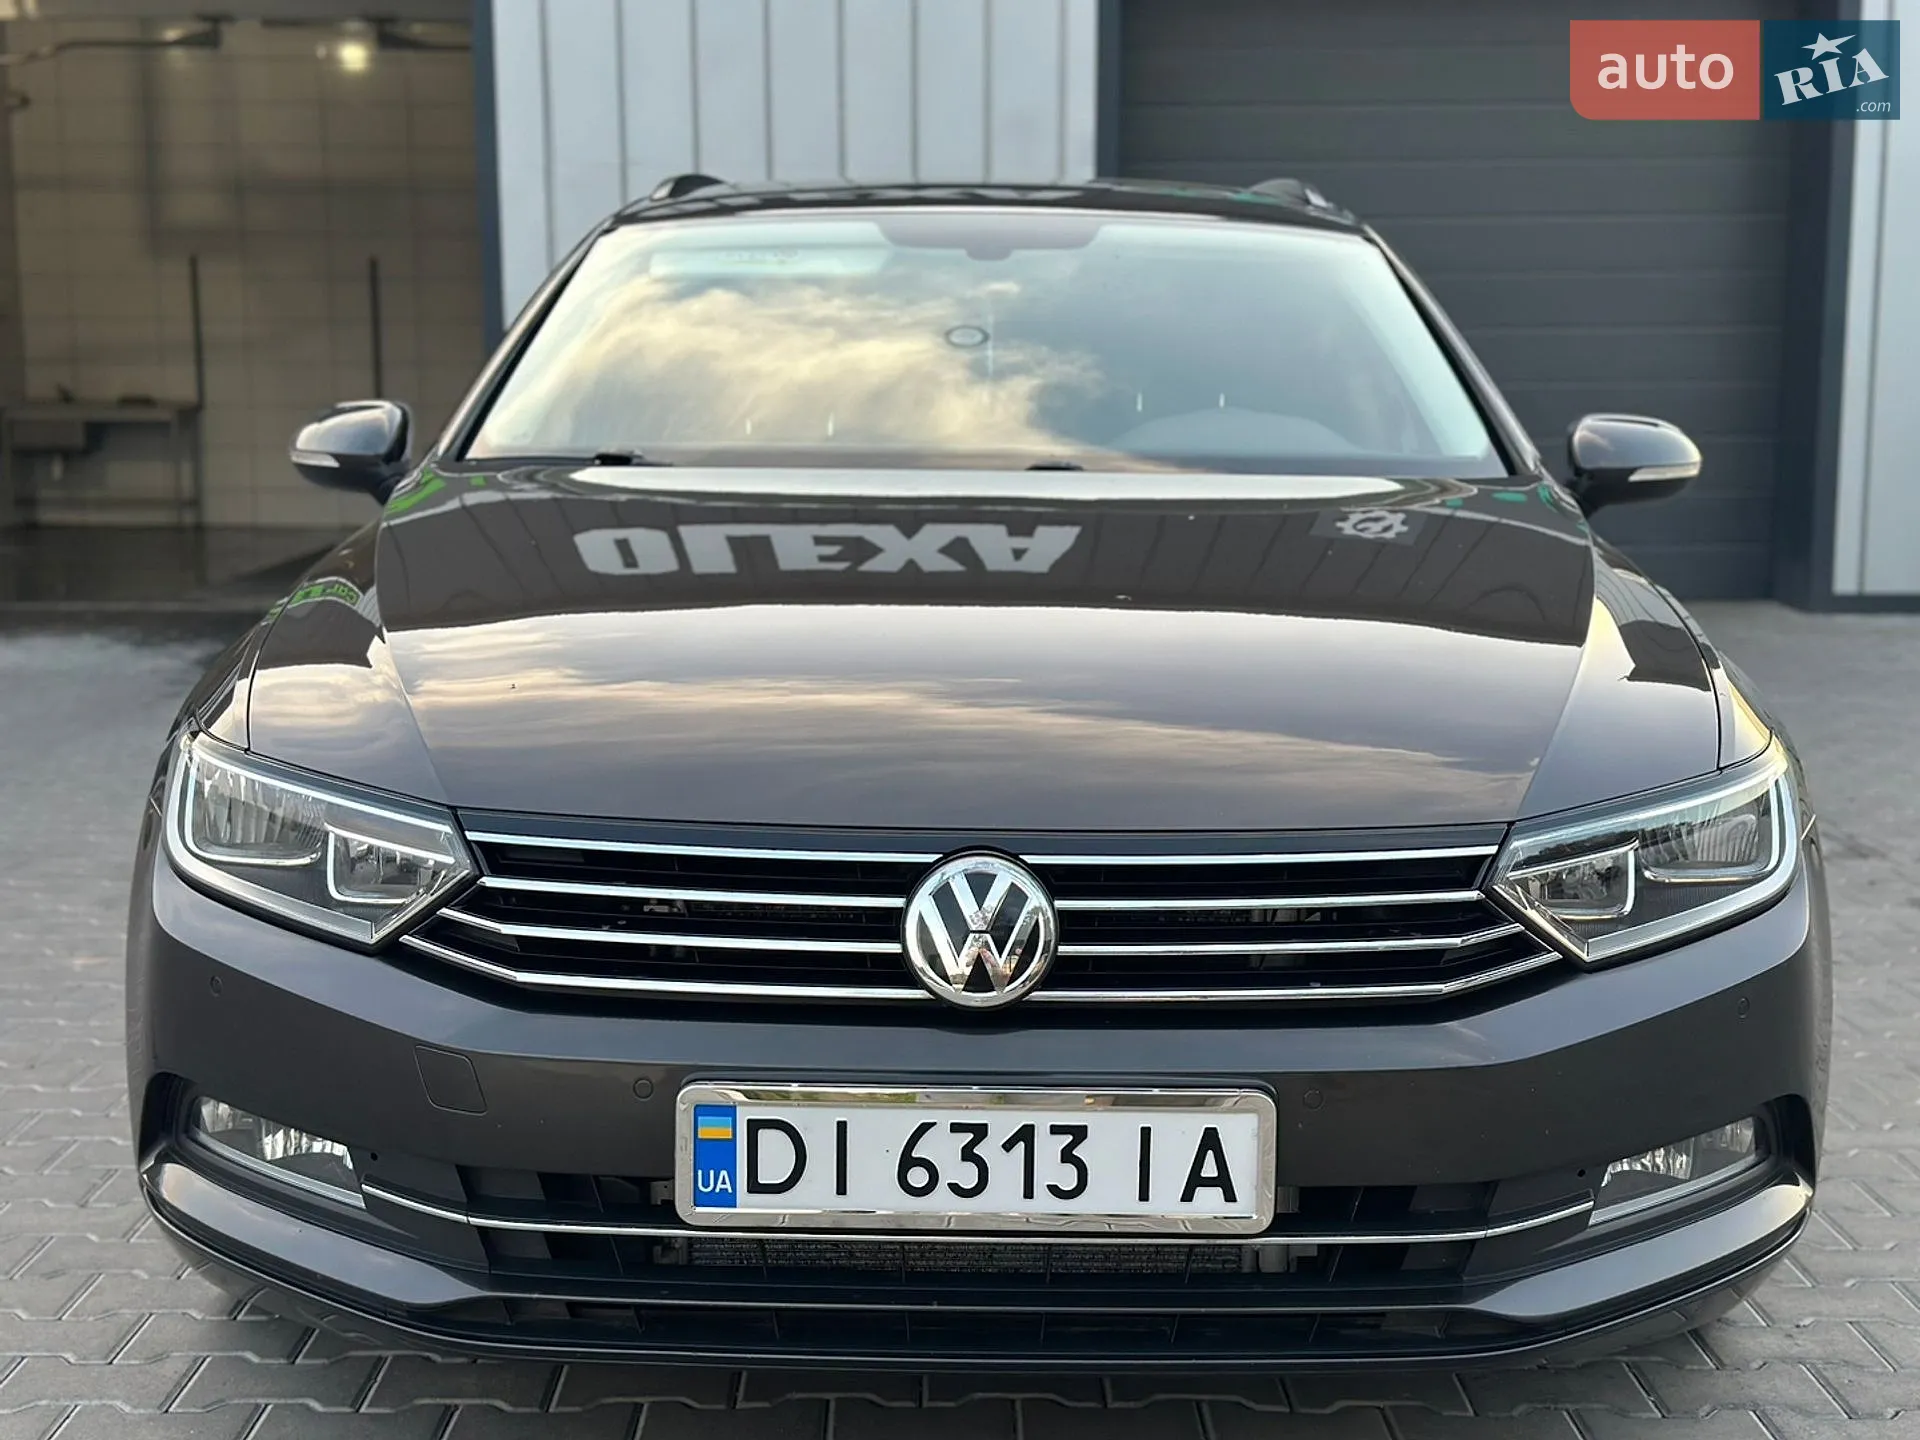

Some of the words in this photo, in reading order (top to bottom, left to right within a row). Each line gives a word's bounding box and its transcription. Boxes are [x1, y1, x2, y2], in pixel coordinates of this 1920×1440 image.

[698, 1169, 732, 1193] UA
[746, 1117, 848, 1196] DI
[896, 1121, 1089, 1199] 6313
[1138, 1125, 1238, 1203] IA
